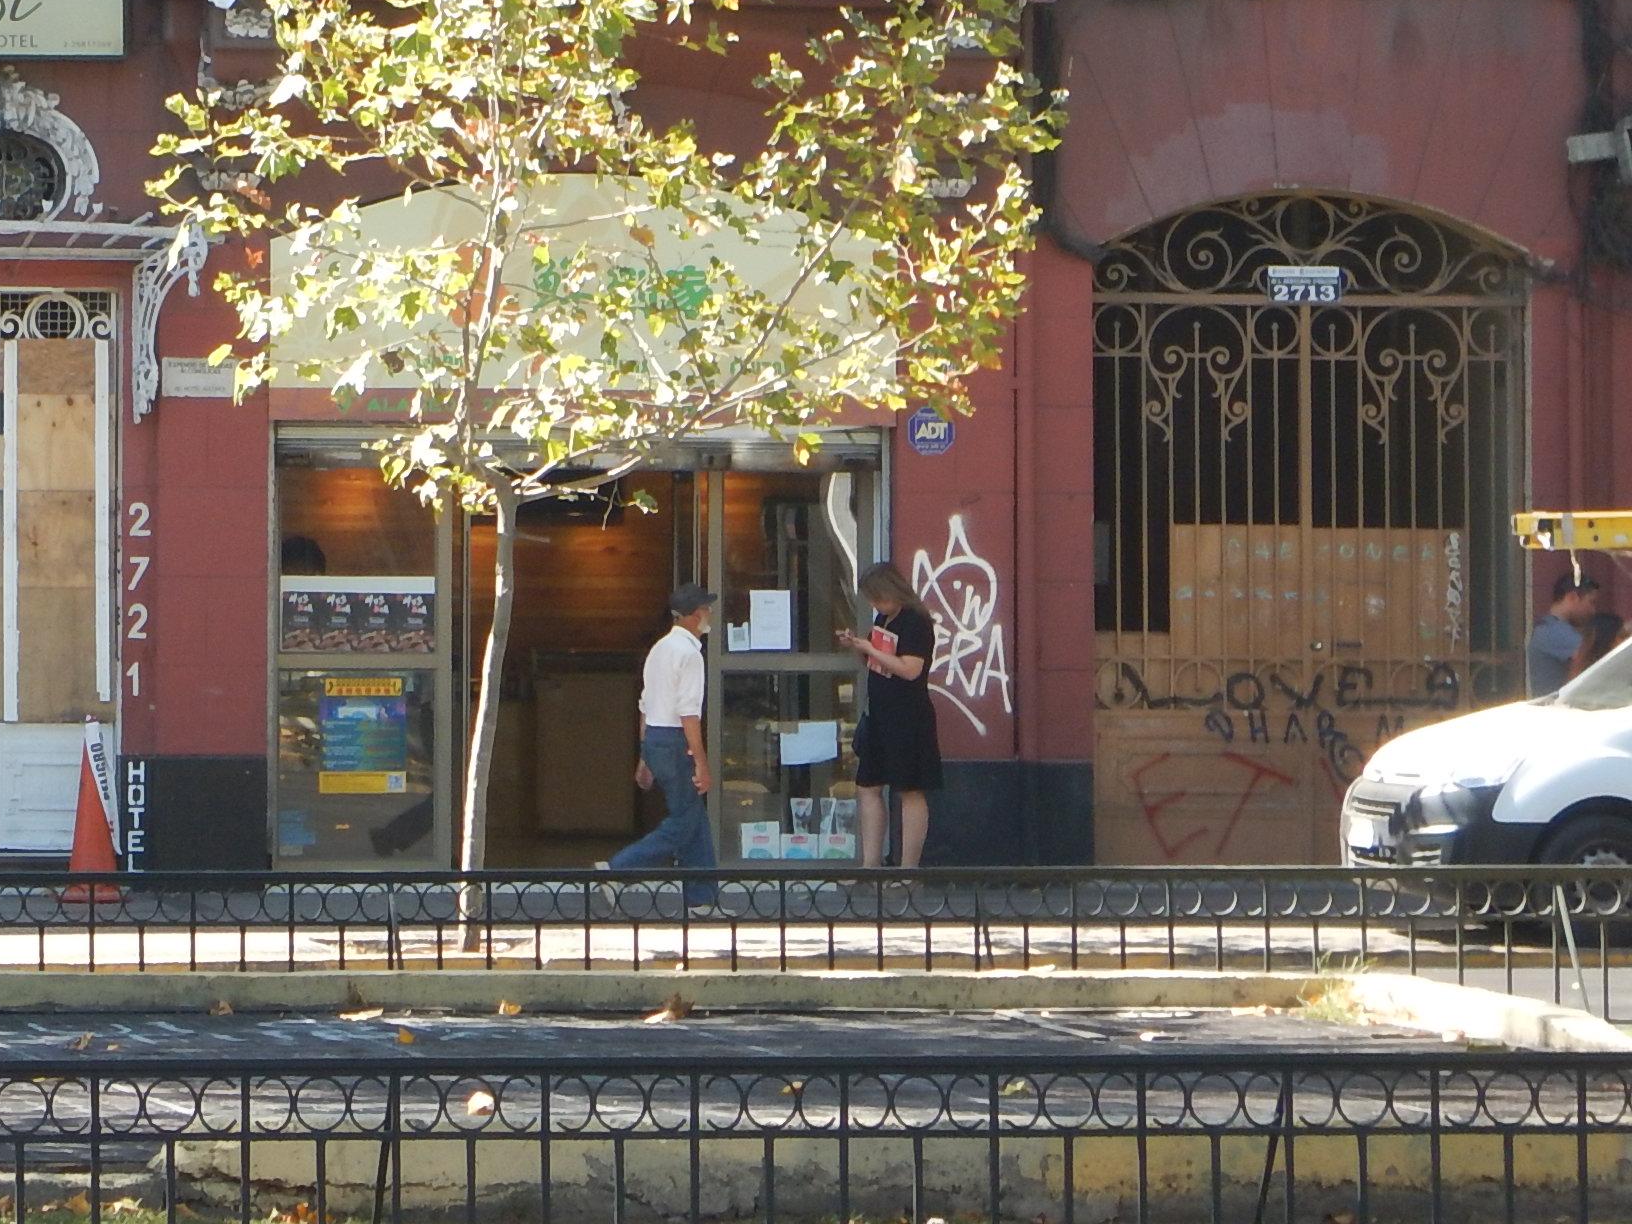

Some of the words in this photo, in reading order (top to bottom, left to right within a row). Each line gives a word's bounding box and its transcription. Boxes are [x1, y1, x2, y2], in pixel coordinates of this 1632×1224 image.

[1273, 284, 1336, 302] 2713
[915, 421, 948, 440] ADT
[127, 761, 146, 874] HOTEL
